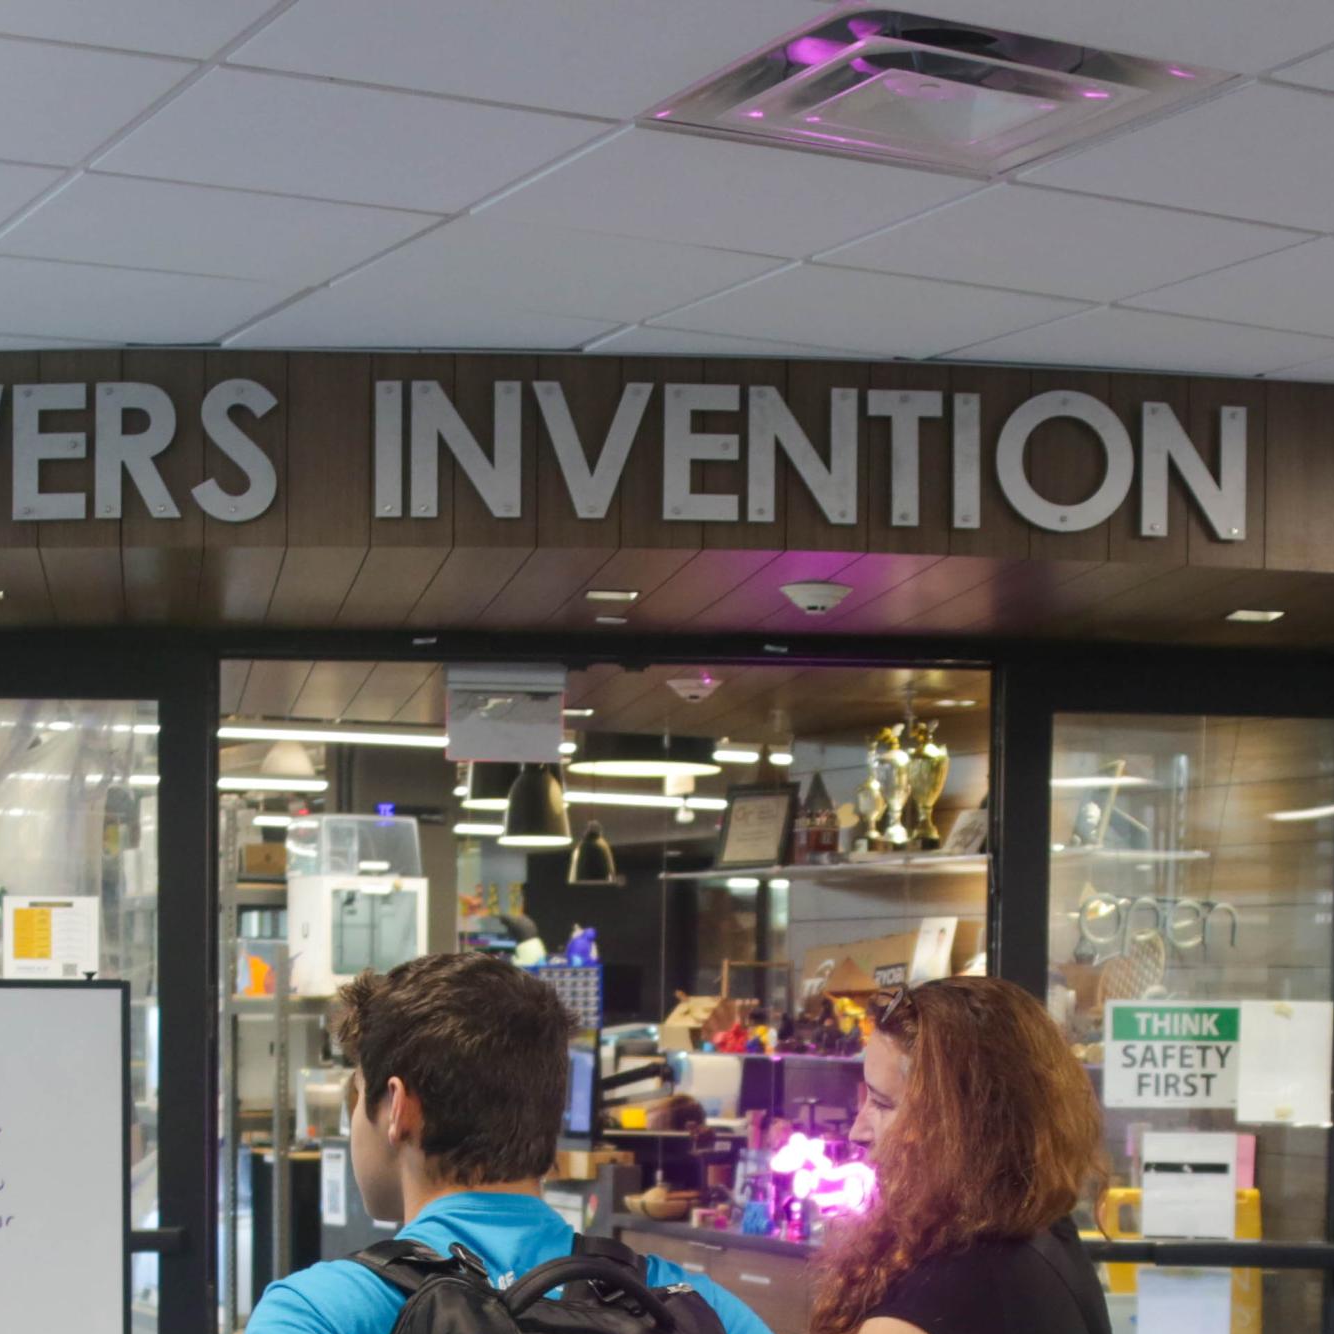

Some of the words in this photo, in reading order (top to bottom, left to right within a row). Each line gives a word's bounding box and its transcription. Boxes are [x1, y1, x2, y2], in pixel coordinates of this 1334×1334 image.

[375, 380, 1247, 541] INVENTION
[1134, 1011, 1220, 1037] THINK
[1121, 1044, 1232, 1069] SAFETY
[1136, 1073, 1217, 1097] FIRST
